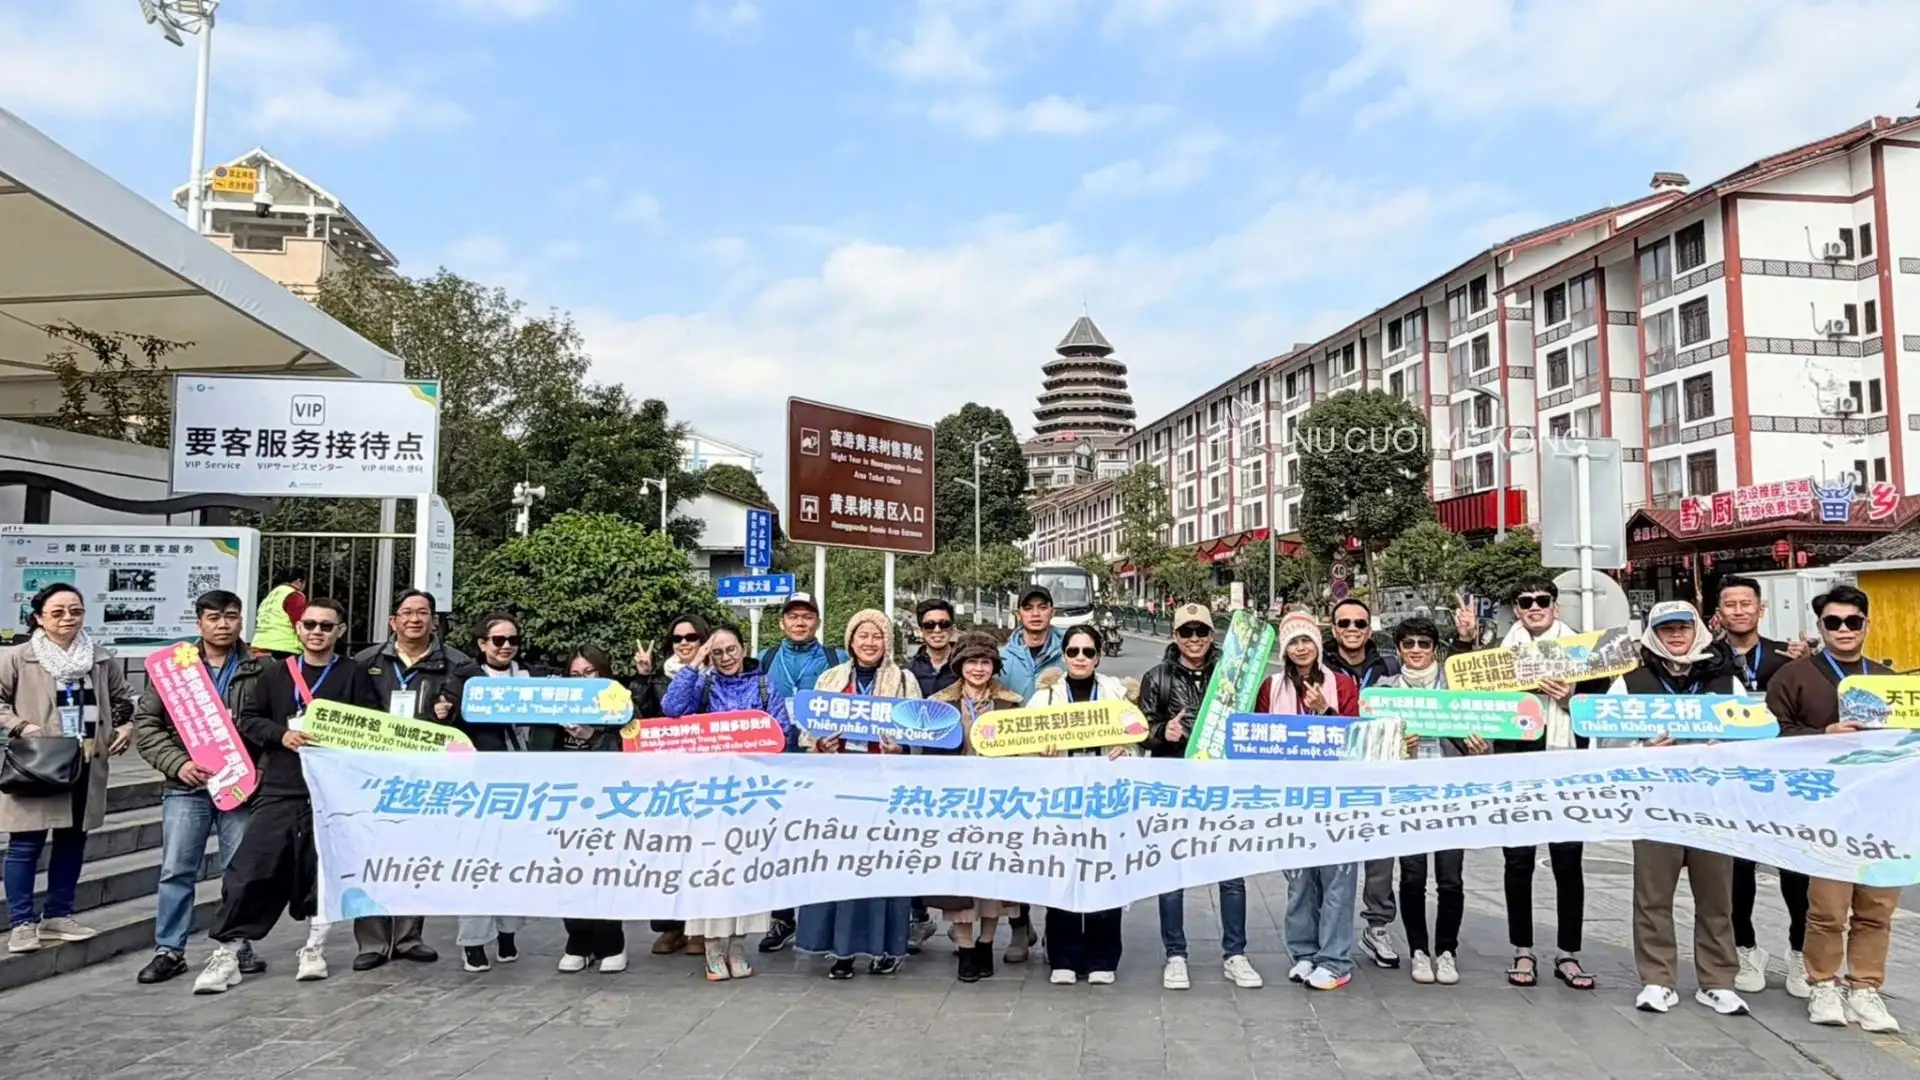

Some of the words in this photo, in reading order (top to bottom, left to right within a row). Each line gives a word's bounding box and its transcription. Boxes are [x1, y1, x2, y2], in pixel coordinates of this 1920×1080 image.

[295, 402, 322, 418] VIP
[185, 427, 424, 461] 要客服务接待点
[830, 429, 924, 462] 夜游黄果树售票处
[185, 461, 201, 470] VIP
[205, 461, 241, 470] Service
[829, 493, 925, 524] 黄果树景区入口
[65, 543, 194, 554] 黄果树景区要客服务
[1333, 565, 1346, 577] 40
[1480, 601, 1490, 615] P
[1452, 652, 1514, 673] 山水福地
[1455, 667, 1516, 687] 千年镇远
[809, 697, 892, 722] 中国天眼
[1595, 698, 1702, 720] 天空之桥
[806, 718, 838, 732] Thiên
[1231, 722, 1347, 745] 亚洲第一瀑布
[1581, 720, 1618, 732] Thiên
[1233, 743, 1256, 753] Thác
[1258, 743, 1284, 754] nước
[548, 828, 615, 856] “Việt
[624, 829, 691, 852] Nam
[725, 818, 776, 854] Quý
[785, 818, 857, 841] Châu
[867, 820, 939, 854] cùng
[948, 826, 1023, 854] đồng
[1033, 825, 1106, 849] hành
[1137, 813, 1188, 837] Văn
[1200, 815, 1254, 831] hóa
[1269, 813, 1302, 827] du
[1315, 806, 1372, 829] lịch
[1379, 798, 1462, 818] cùng
[1468, 789, 1546, 811] phát
[363, 857, 444, 888] Nhiệt
[452, 859, 502, 888] liệt
[510, 858, 582, 884] chào
[591, 854, 681, 894] mừng
[689, 861, 735, 887] các
[744, 846, 828, 883] doanh
[838, 849, 941, 876] nghiệp
[952, 852, 982, 870] lữ
[989, 852, 1064, 877] hành
[1076, 859, 1115, 882] TP.
[1126, 844, 1161, 874] Hồ
[1171, 836, 1219, 860] Chí
[1227, 829, 1316, 851] Minh,
[1326, 818, 1388, 842] Việt
[1400, 809, 1476, 832] Nam
[1485, 803, 1552, 824] đến
[1564, 803, 1632, 823] Quý
[1645, 808, 1737, 829] Châu
[1746, 820, 1837, 847] khảo
[1847, 834, 1910, 859] sát.
